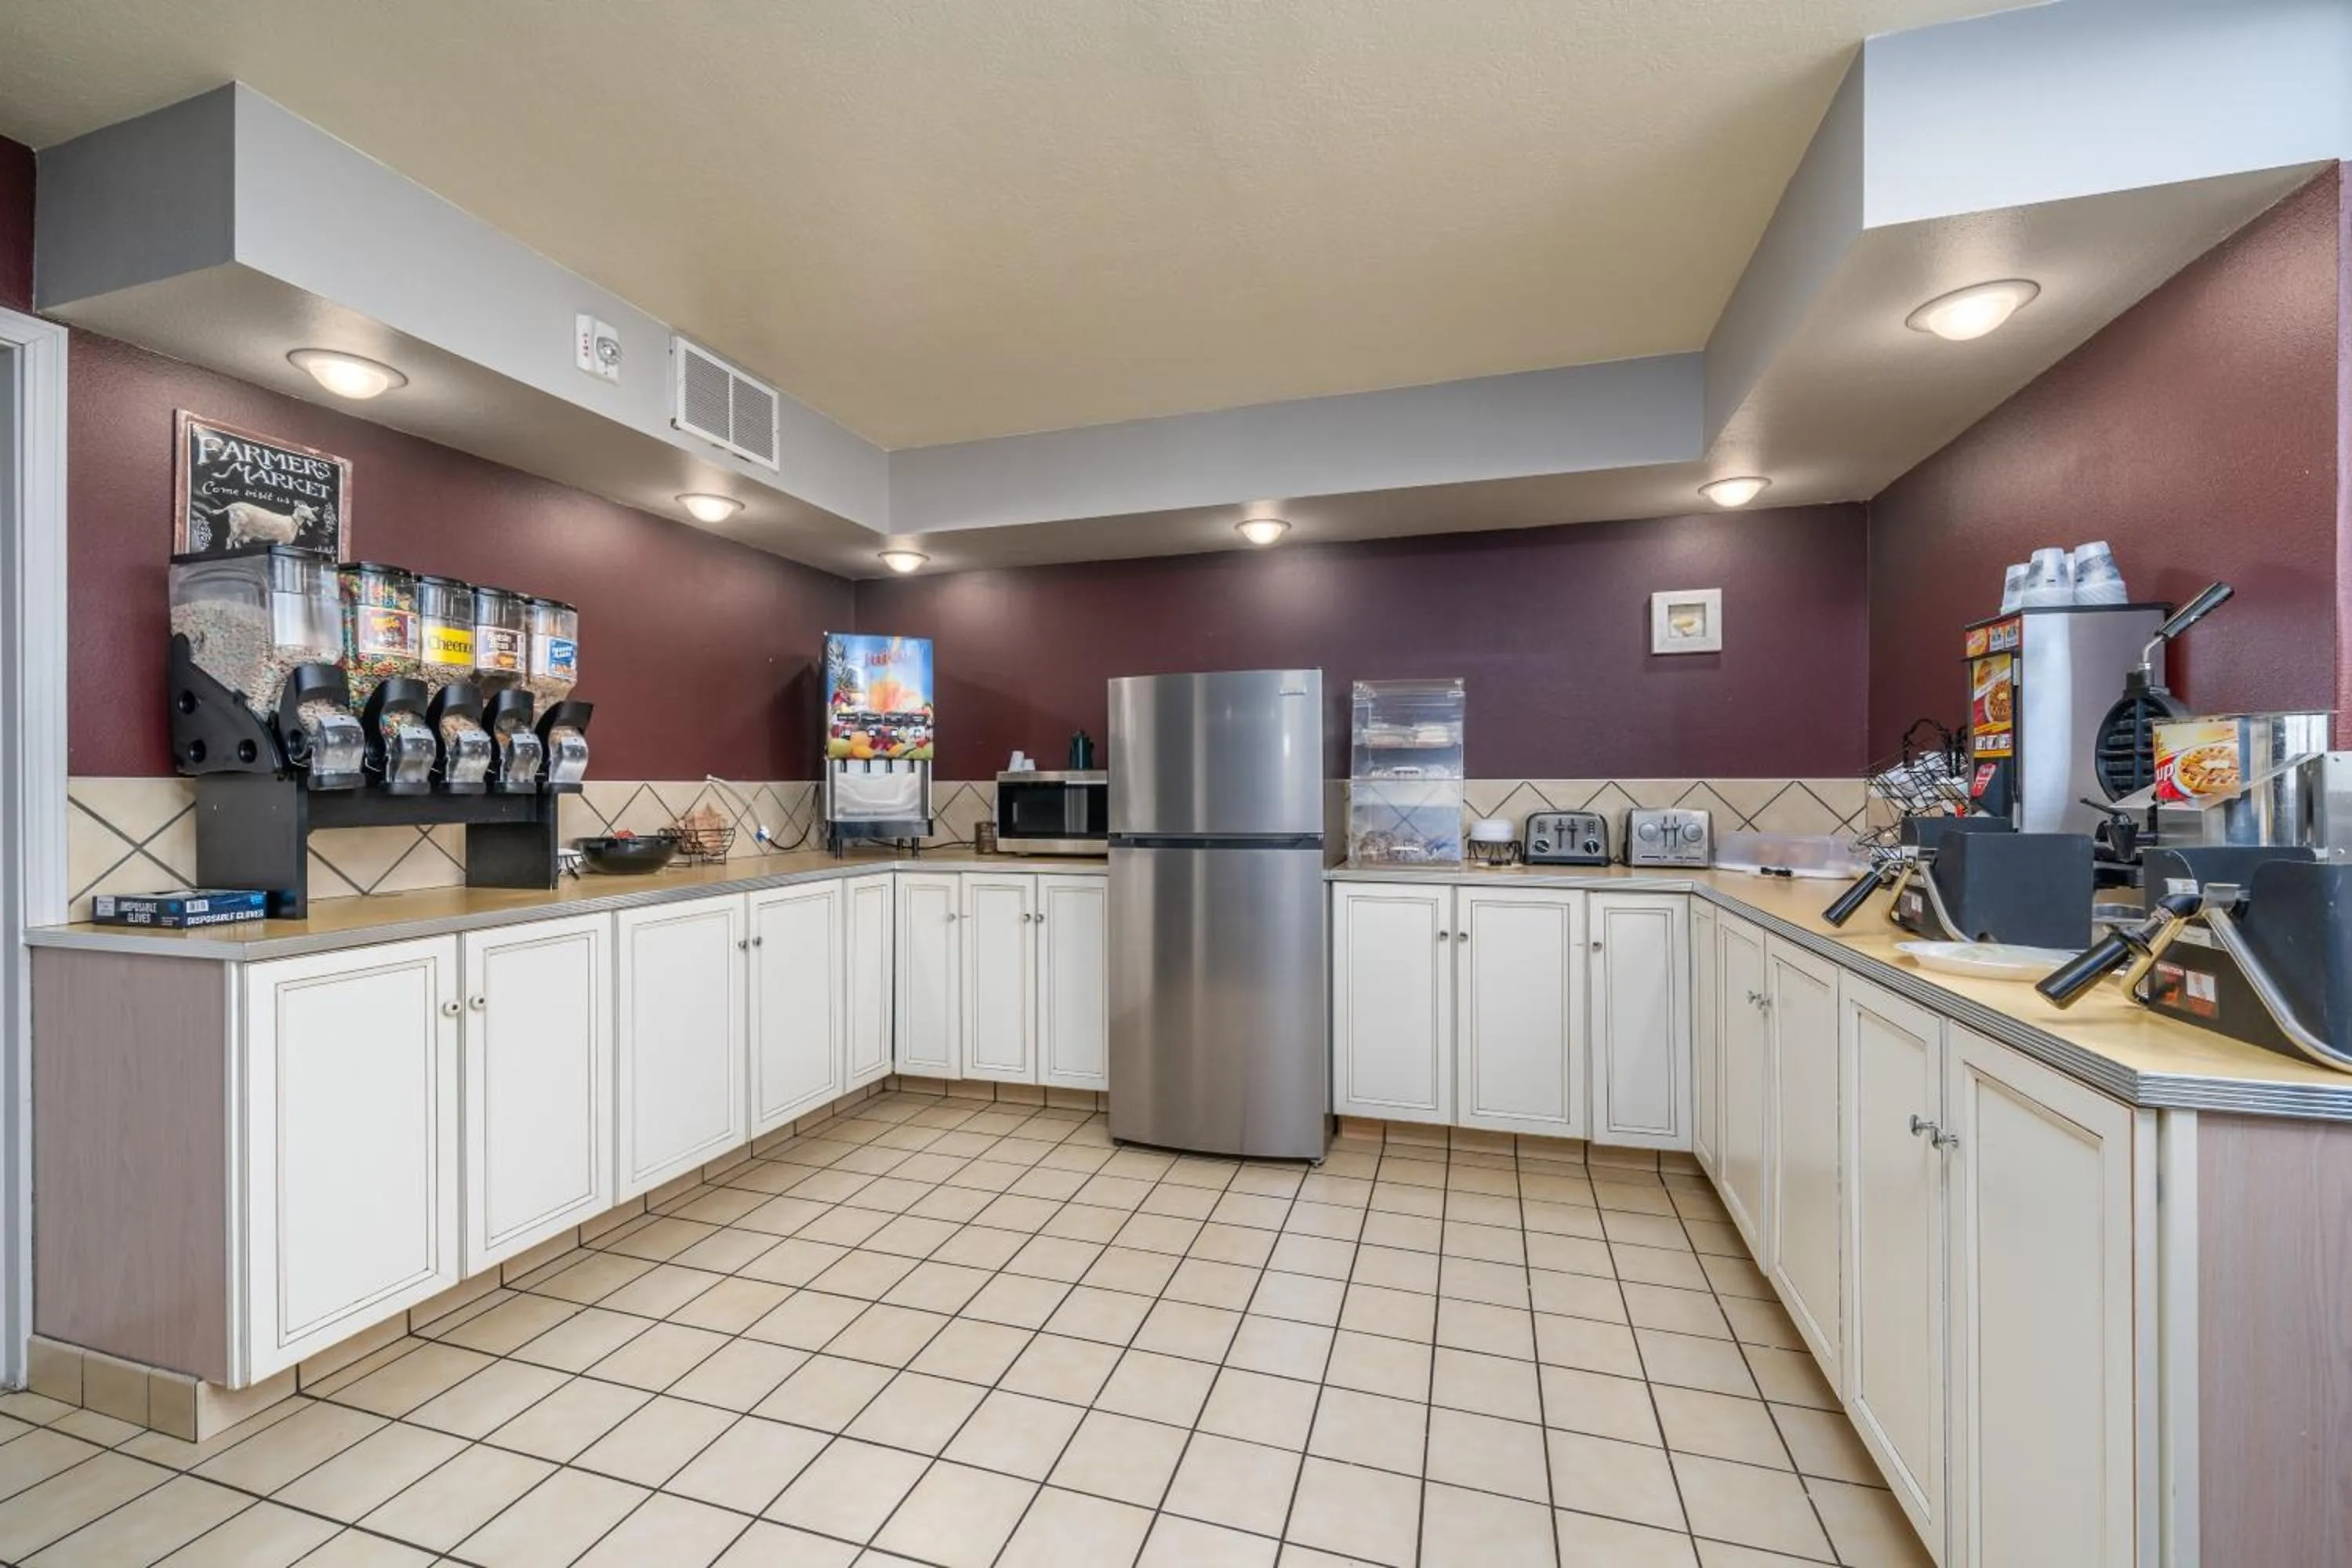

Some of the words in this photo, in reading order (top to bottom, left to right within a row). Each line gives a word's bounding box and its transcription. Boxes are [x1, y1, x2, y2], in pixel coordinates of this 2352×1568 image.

[198, 437, 331, 479] FARMERS
[202, 481, 239, 495] Come
[245, 490, 274, 502] visit
[212, 463, 331, 499] MARKET
